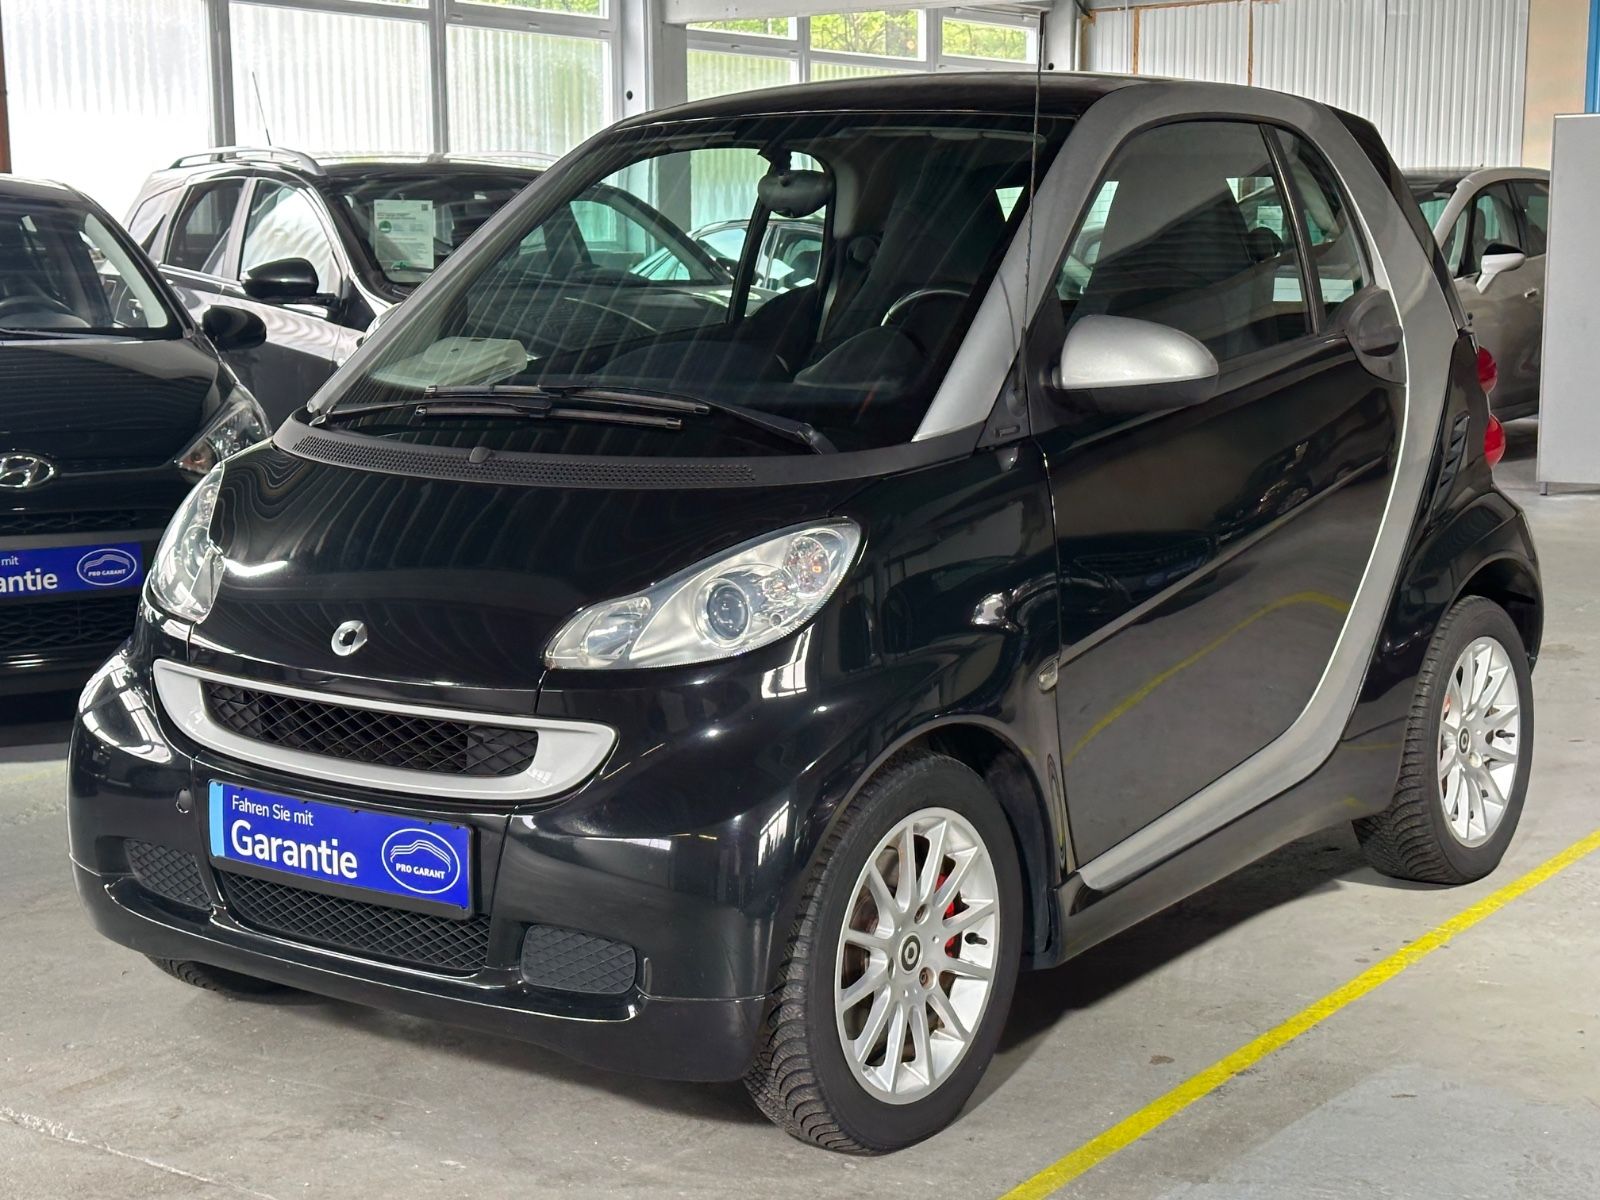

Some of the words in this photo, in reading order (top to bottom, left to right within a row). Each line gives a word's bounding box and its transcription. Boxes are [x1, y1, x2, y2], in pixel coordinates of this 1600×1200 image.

[1, 555, 20, 566] mit
[232, 795, 269, 818] Fahren
[273, 803, 291, 821] Sie
[293, 810, 314, 827] mit
[231, 819, 358, 879] Garantie
[395, 863, 412, 873] PRO
[413, 866, 446, 880] GARANT
